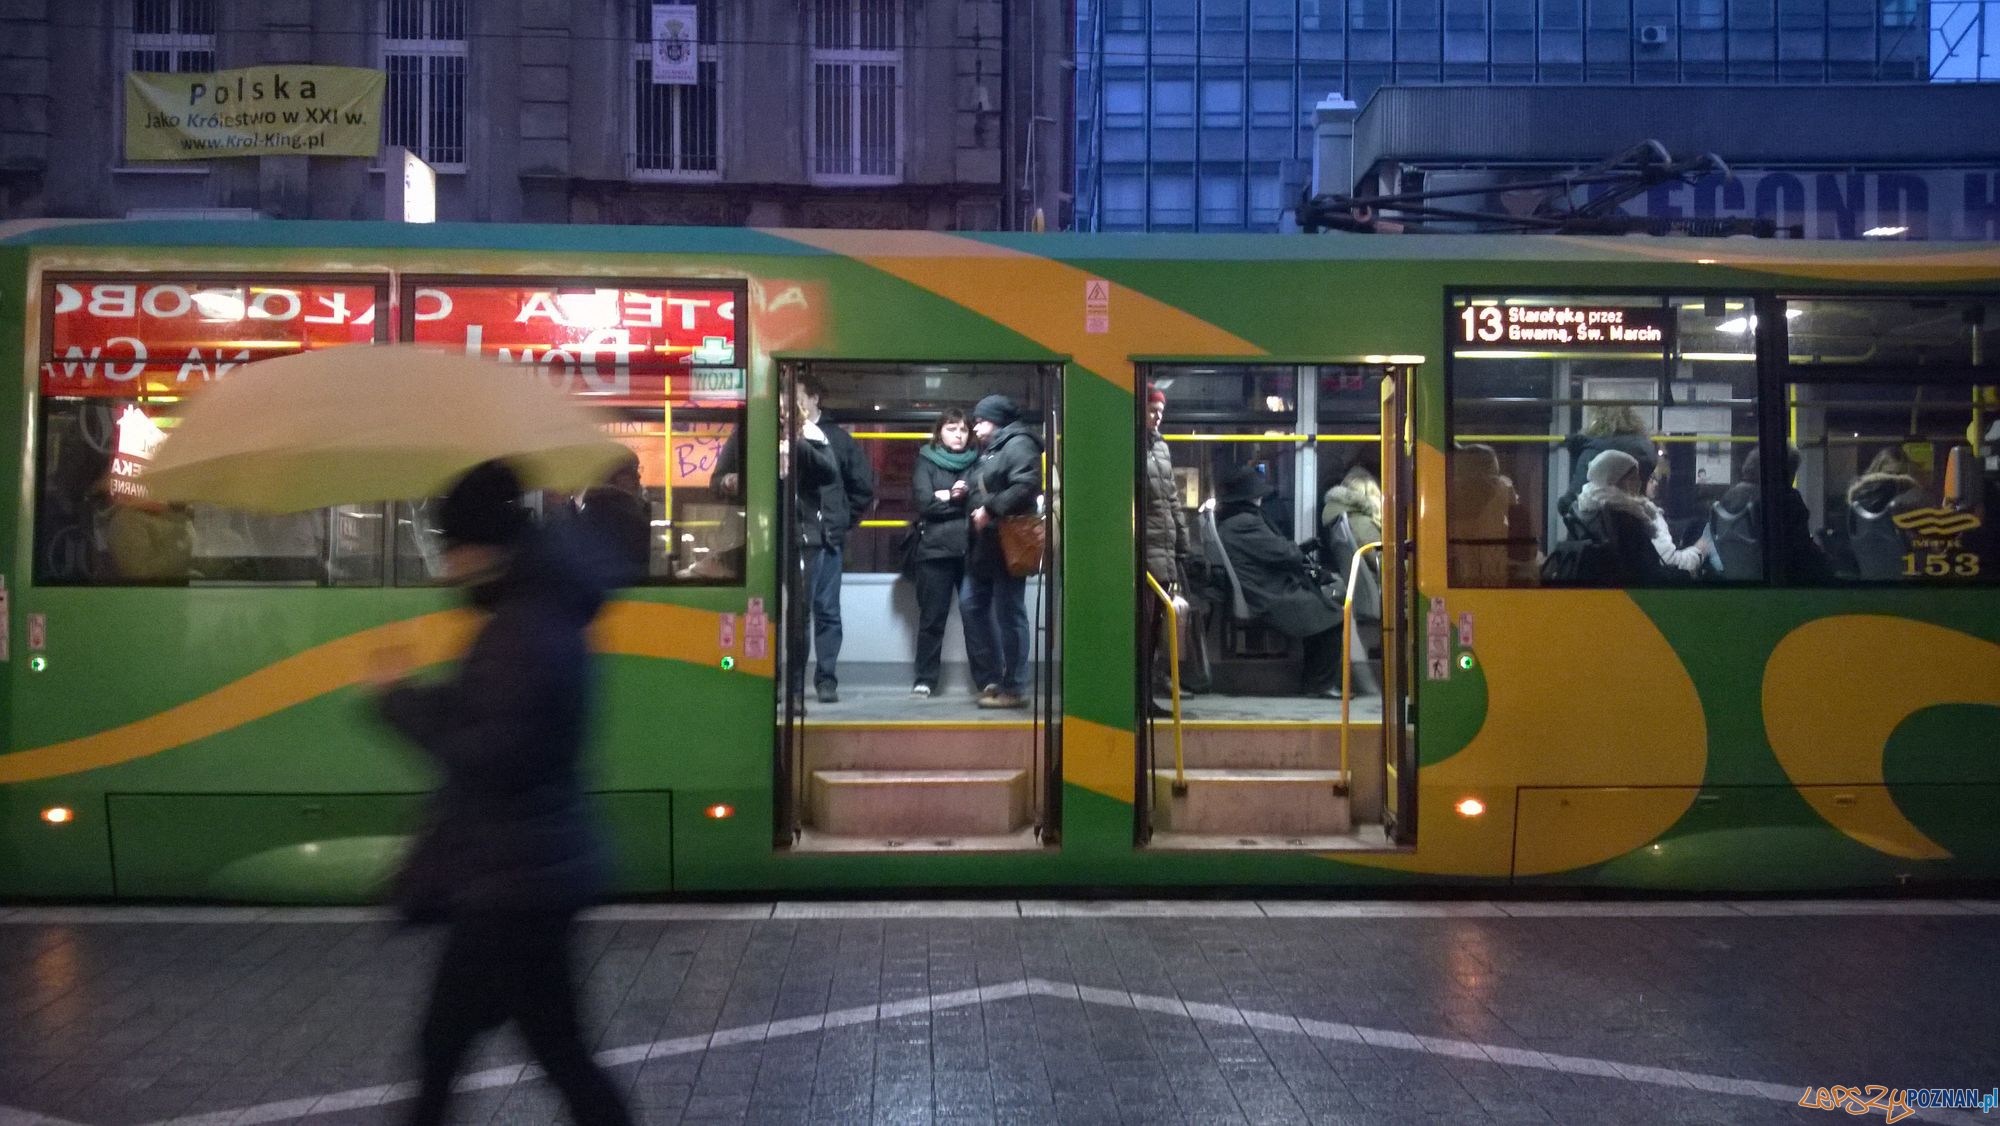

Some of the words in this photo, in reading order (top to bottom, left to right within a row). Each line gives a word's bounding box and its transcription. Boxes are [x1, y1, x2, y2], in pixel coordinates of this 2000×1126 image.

[189, 74, 317, 106] Polska
[144, 111, 180, 129] Jako
[187, 109, 277, 129] Królestwo
[282, 111, 299, 125] w
[305, 107, 338, 125] XXI
[345, 111, 367, 126] w.
[180, 131, 325, 150] www.Krol-King.pl
[1461, 306, 1504, 342] 13
[1508, 306, 1585, 326] Starołęka
[1588, 311, 1623, 326] przez
[1508, 324, 1573, 343] Gwarną,
[1577, 322, 1605, 341] Św.
[1609, 324, 1662, 342] Marcin
[1901, 551, 1981, 577] 153
